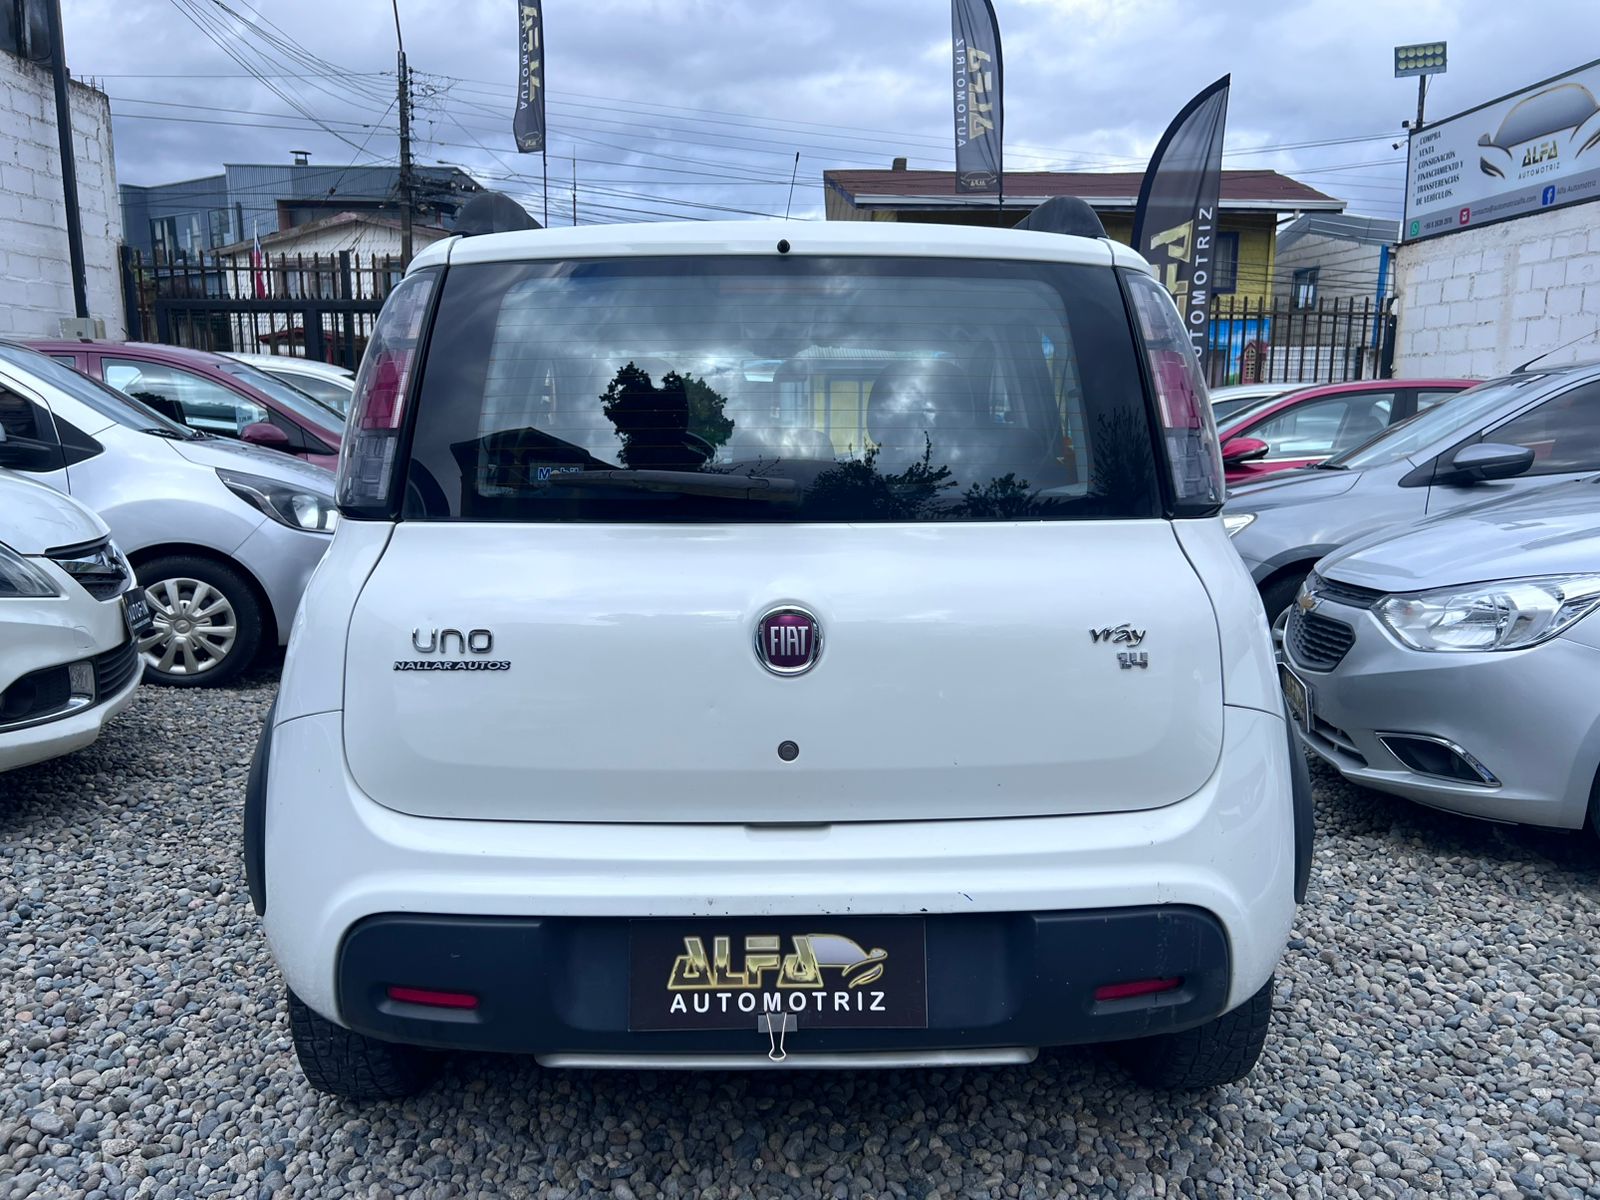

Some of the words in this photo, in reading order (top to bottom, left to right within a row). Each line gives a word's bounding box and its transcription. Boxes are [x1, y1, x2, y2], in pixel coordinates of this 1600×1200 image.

[1419, 131, 1441, 146] COMPRA
[1419, 145, 1435, 158] VENTA
[1521, 140, 1558, 168] ALFA
[1518, 162, 1560, 180] AUTOMOTRIZ
[1415, 198, 1424, 206] DE
[1188, 206, 1213, 358] UTOMOTRIZ
[770, 626, 808, 656] FIAT
[393, 660, 453, 671] NALLAR
[454, 660, 511, 671] AUTOS
[667, 935, 824, 990] ALFA
[670, 991, 886, 1013] AUTOMOTRIZ
